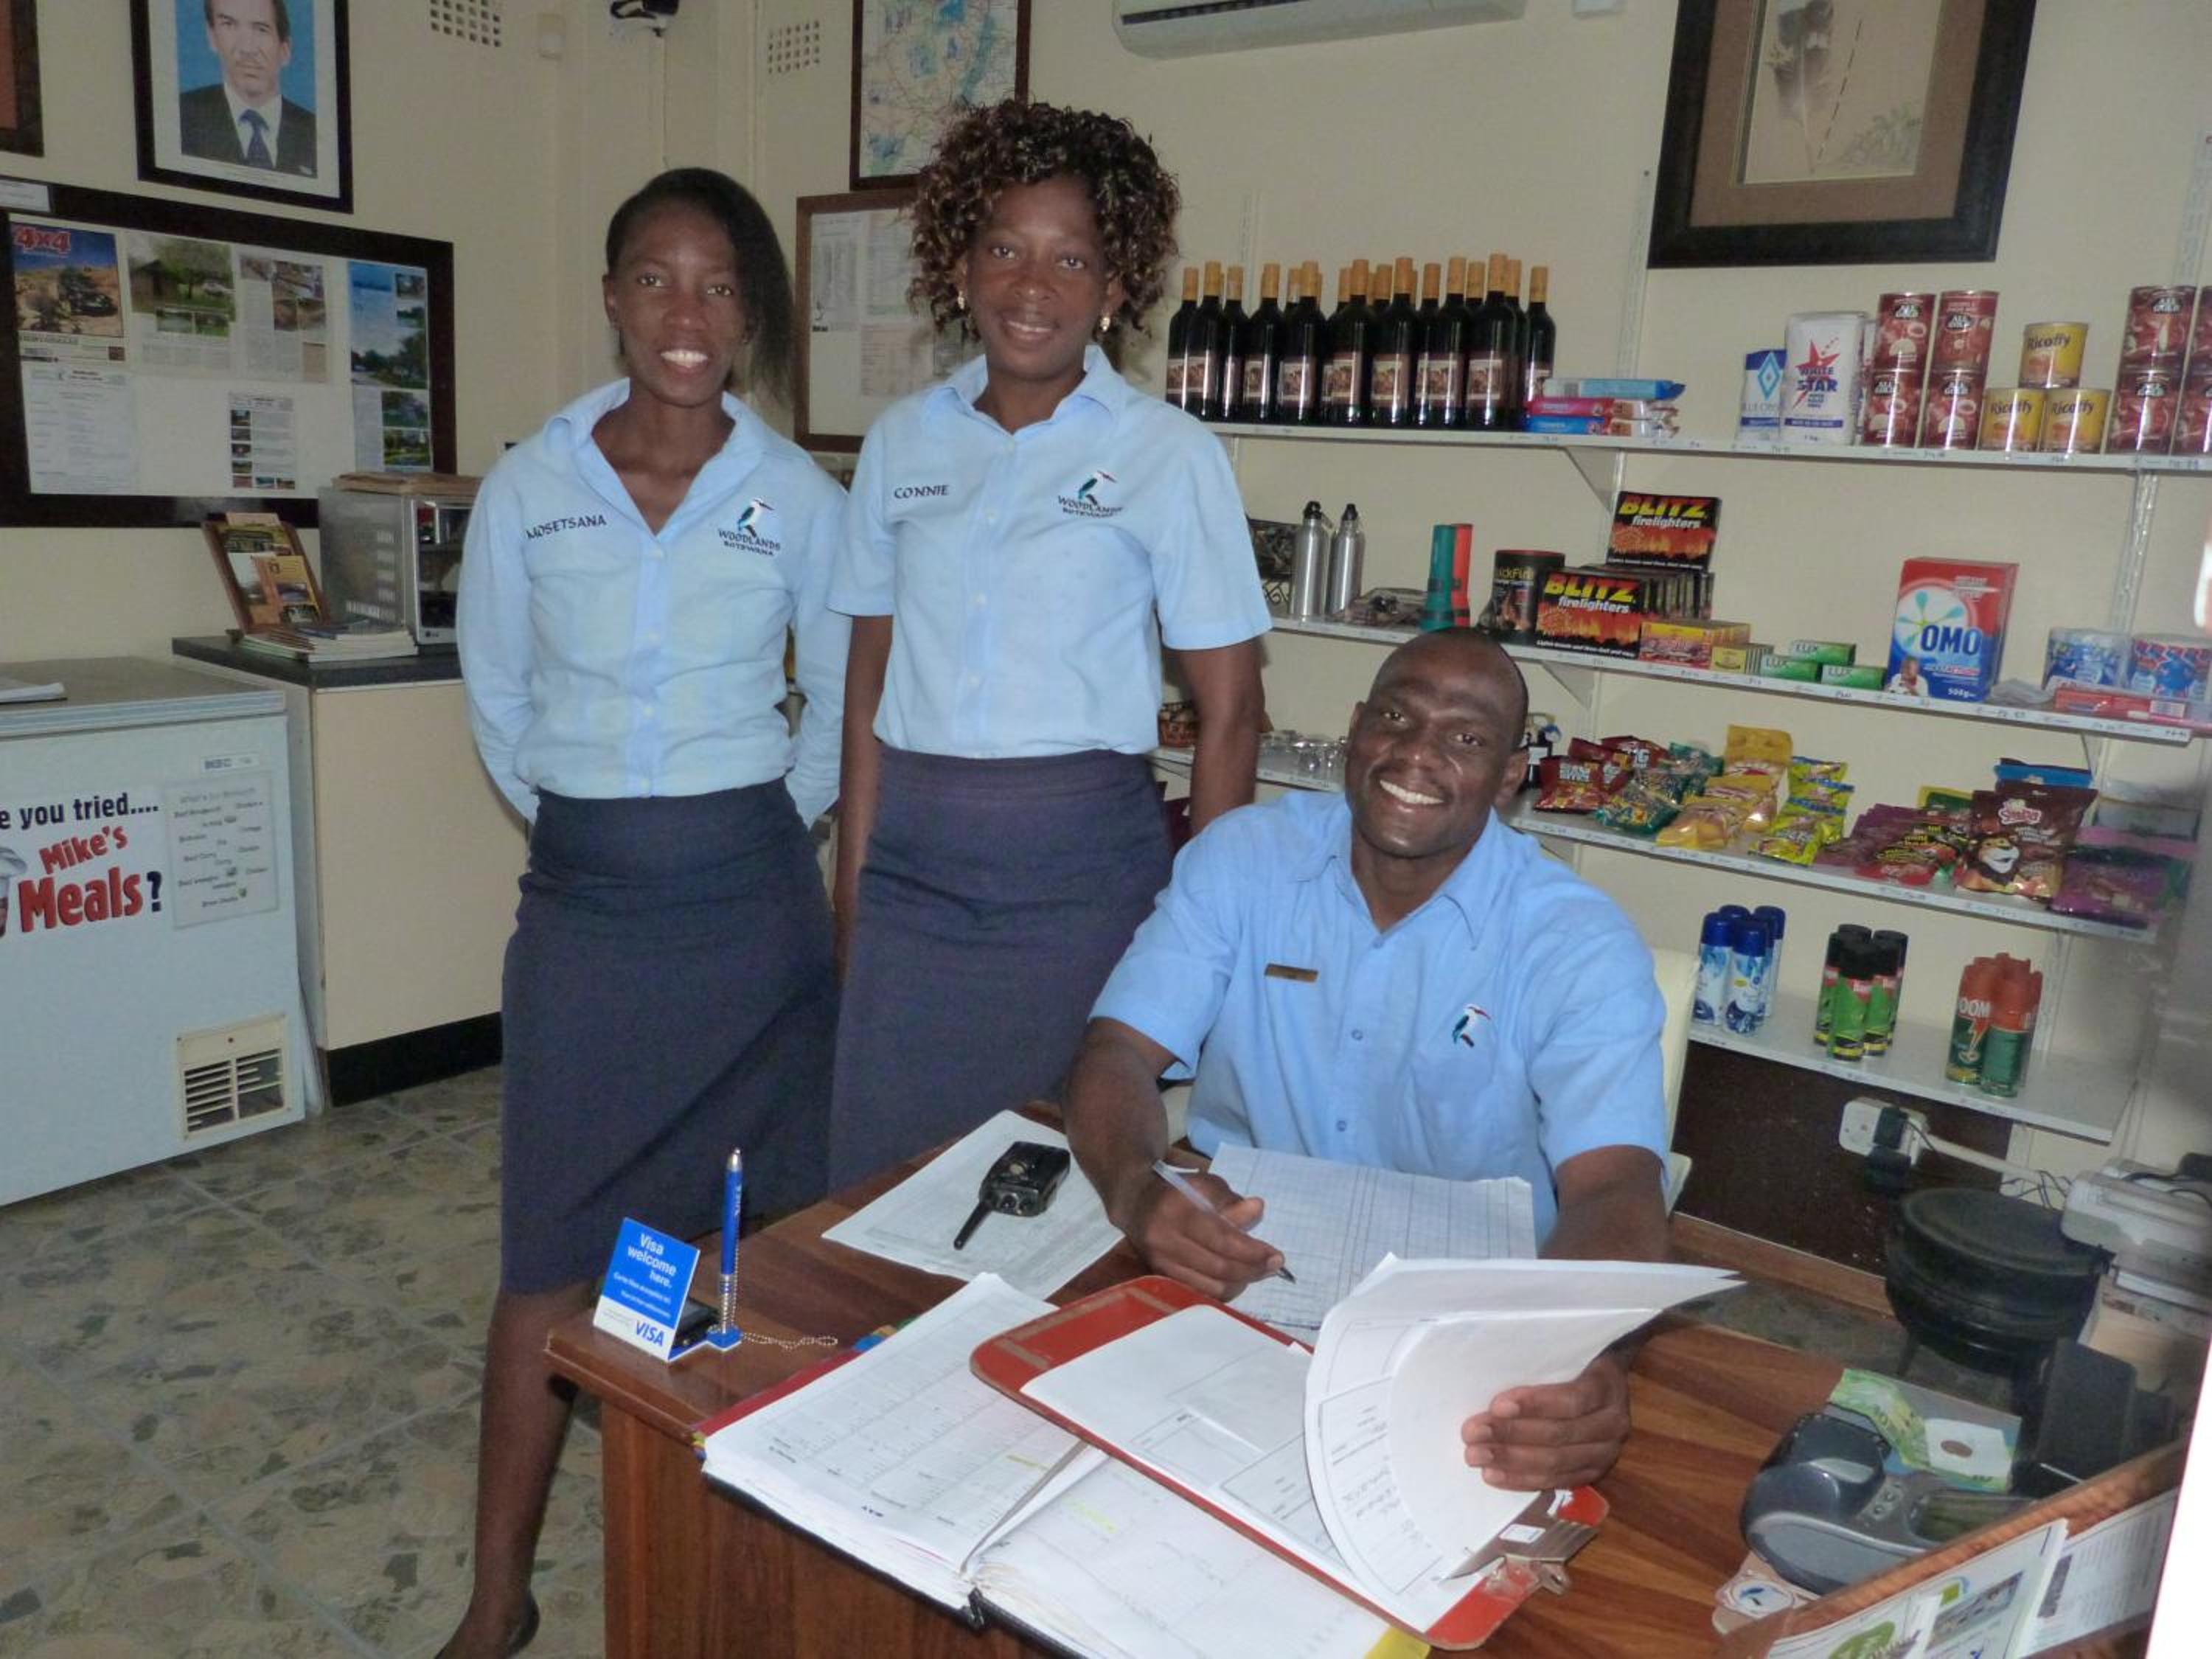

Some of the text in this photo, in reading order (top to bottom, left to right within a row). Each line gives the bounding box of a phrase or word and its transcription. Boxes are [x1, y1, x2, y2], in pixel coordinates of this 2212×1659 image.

[1797, 378, 1838, 392] STAR
[894, 484, 950, 500] CONNIE
[1618, 495, 1707, 518] BLITZ
[526, 513, 608, 541] MOSETSANA
[1632, 515, 1702, 529] firelighters
[718, 528, 782, 552] WOODLANDS
[1545, 574, 1635, 602] BLITZ
[1558, 596, 1631, 613] firelighters
[1921, 625, 1980, 655] OMO
[19, 802, 65, 830] you
[39, 825, 128, 875] Mike's
[17, 866, 164, 933] Meals?
[640, 1233, 664, 1256] Visa
[627, 1245, 677, 1278] welcome
[636, 1319, 664, 1348] VISA
